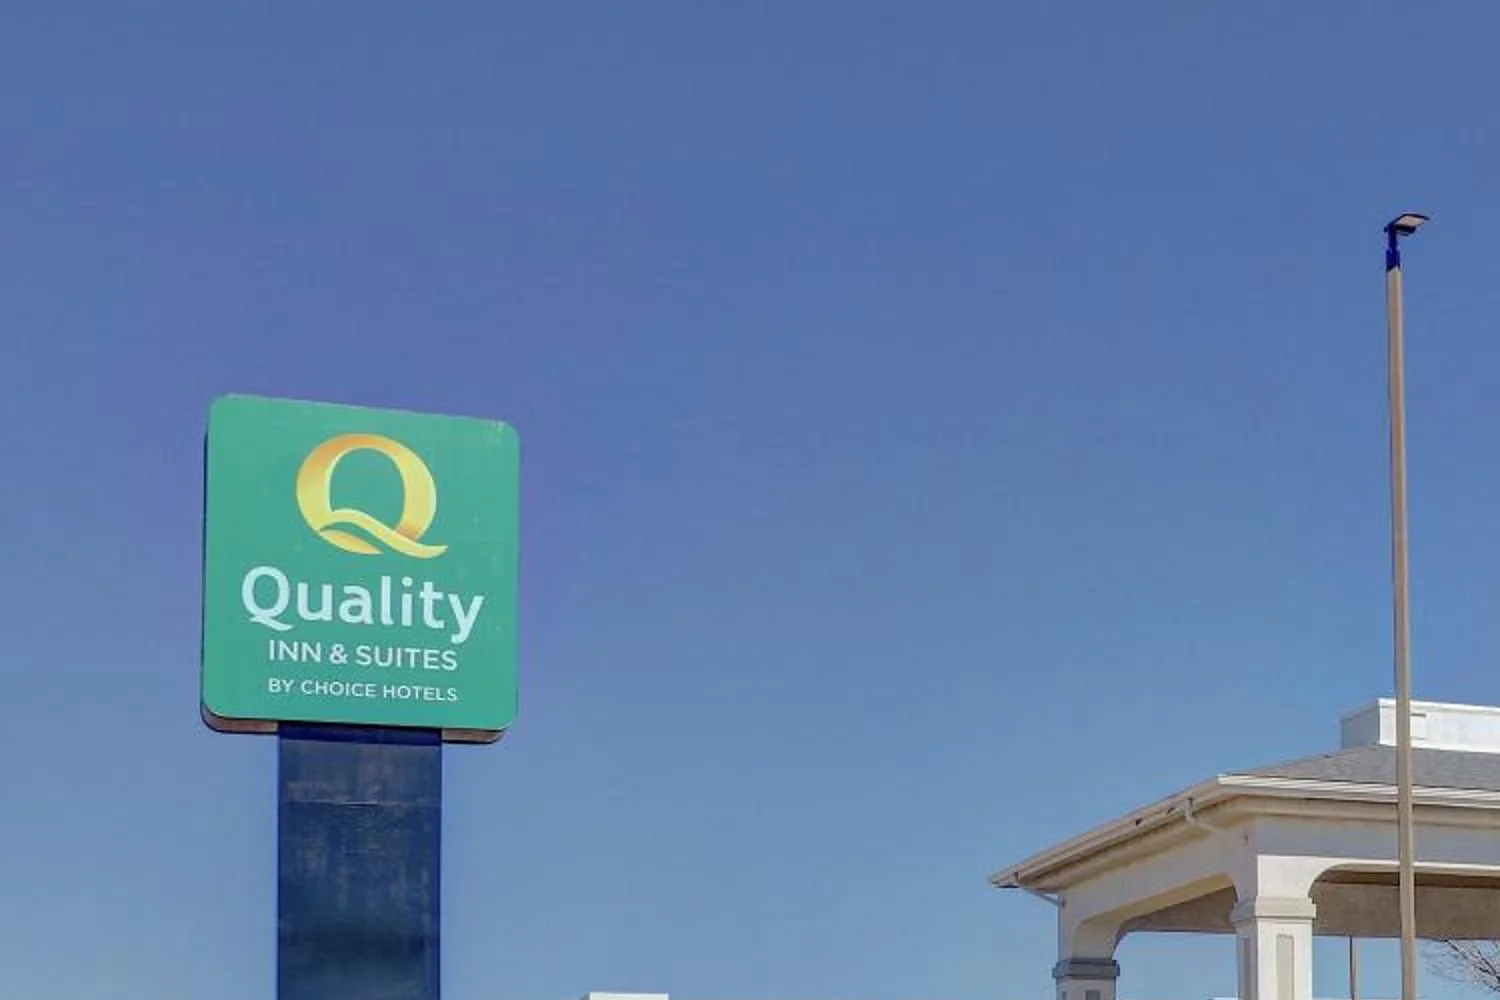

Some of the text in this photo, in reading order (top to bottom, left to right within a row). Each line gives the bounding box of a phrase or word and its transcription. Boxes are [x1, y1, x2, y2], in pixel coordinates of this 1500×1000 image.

[296, 432, 448, 559] Q
[241, 565, 485, 644] Quality
[268, 639, 458, 671] INN & SUITES
[268, 678, 457, 702] BY CHOICE HOTELS
